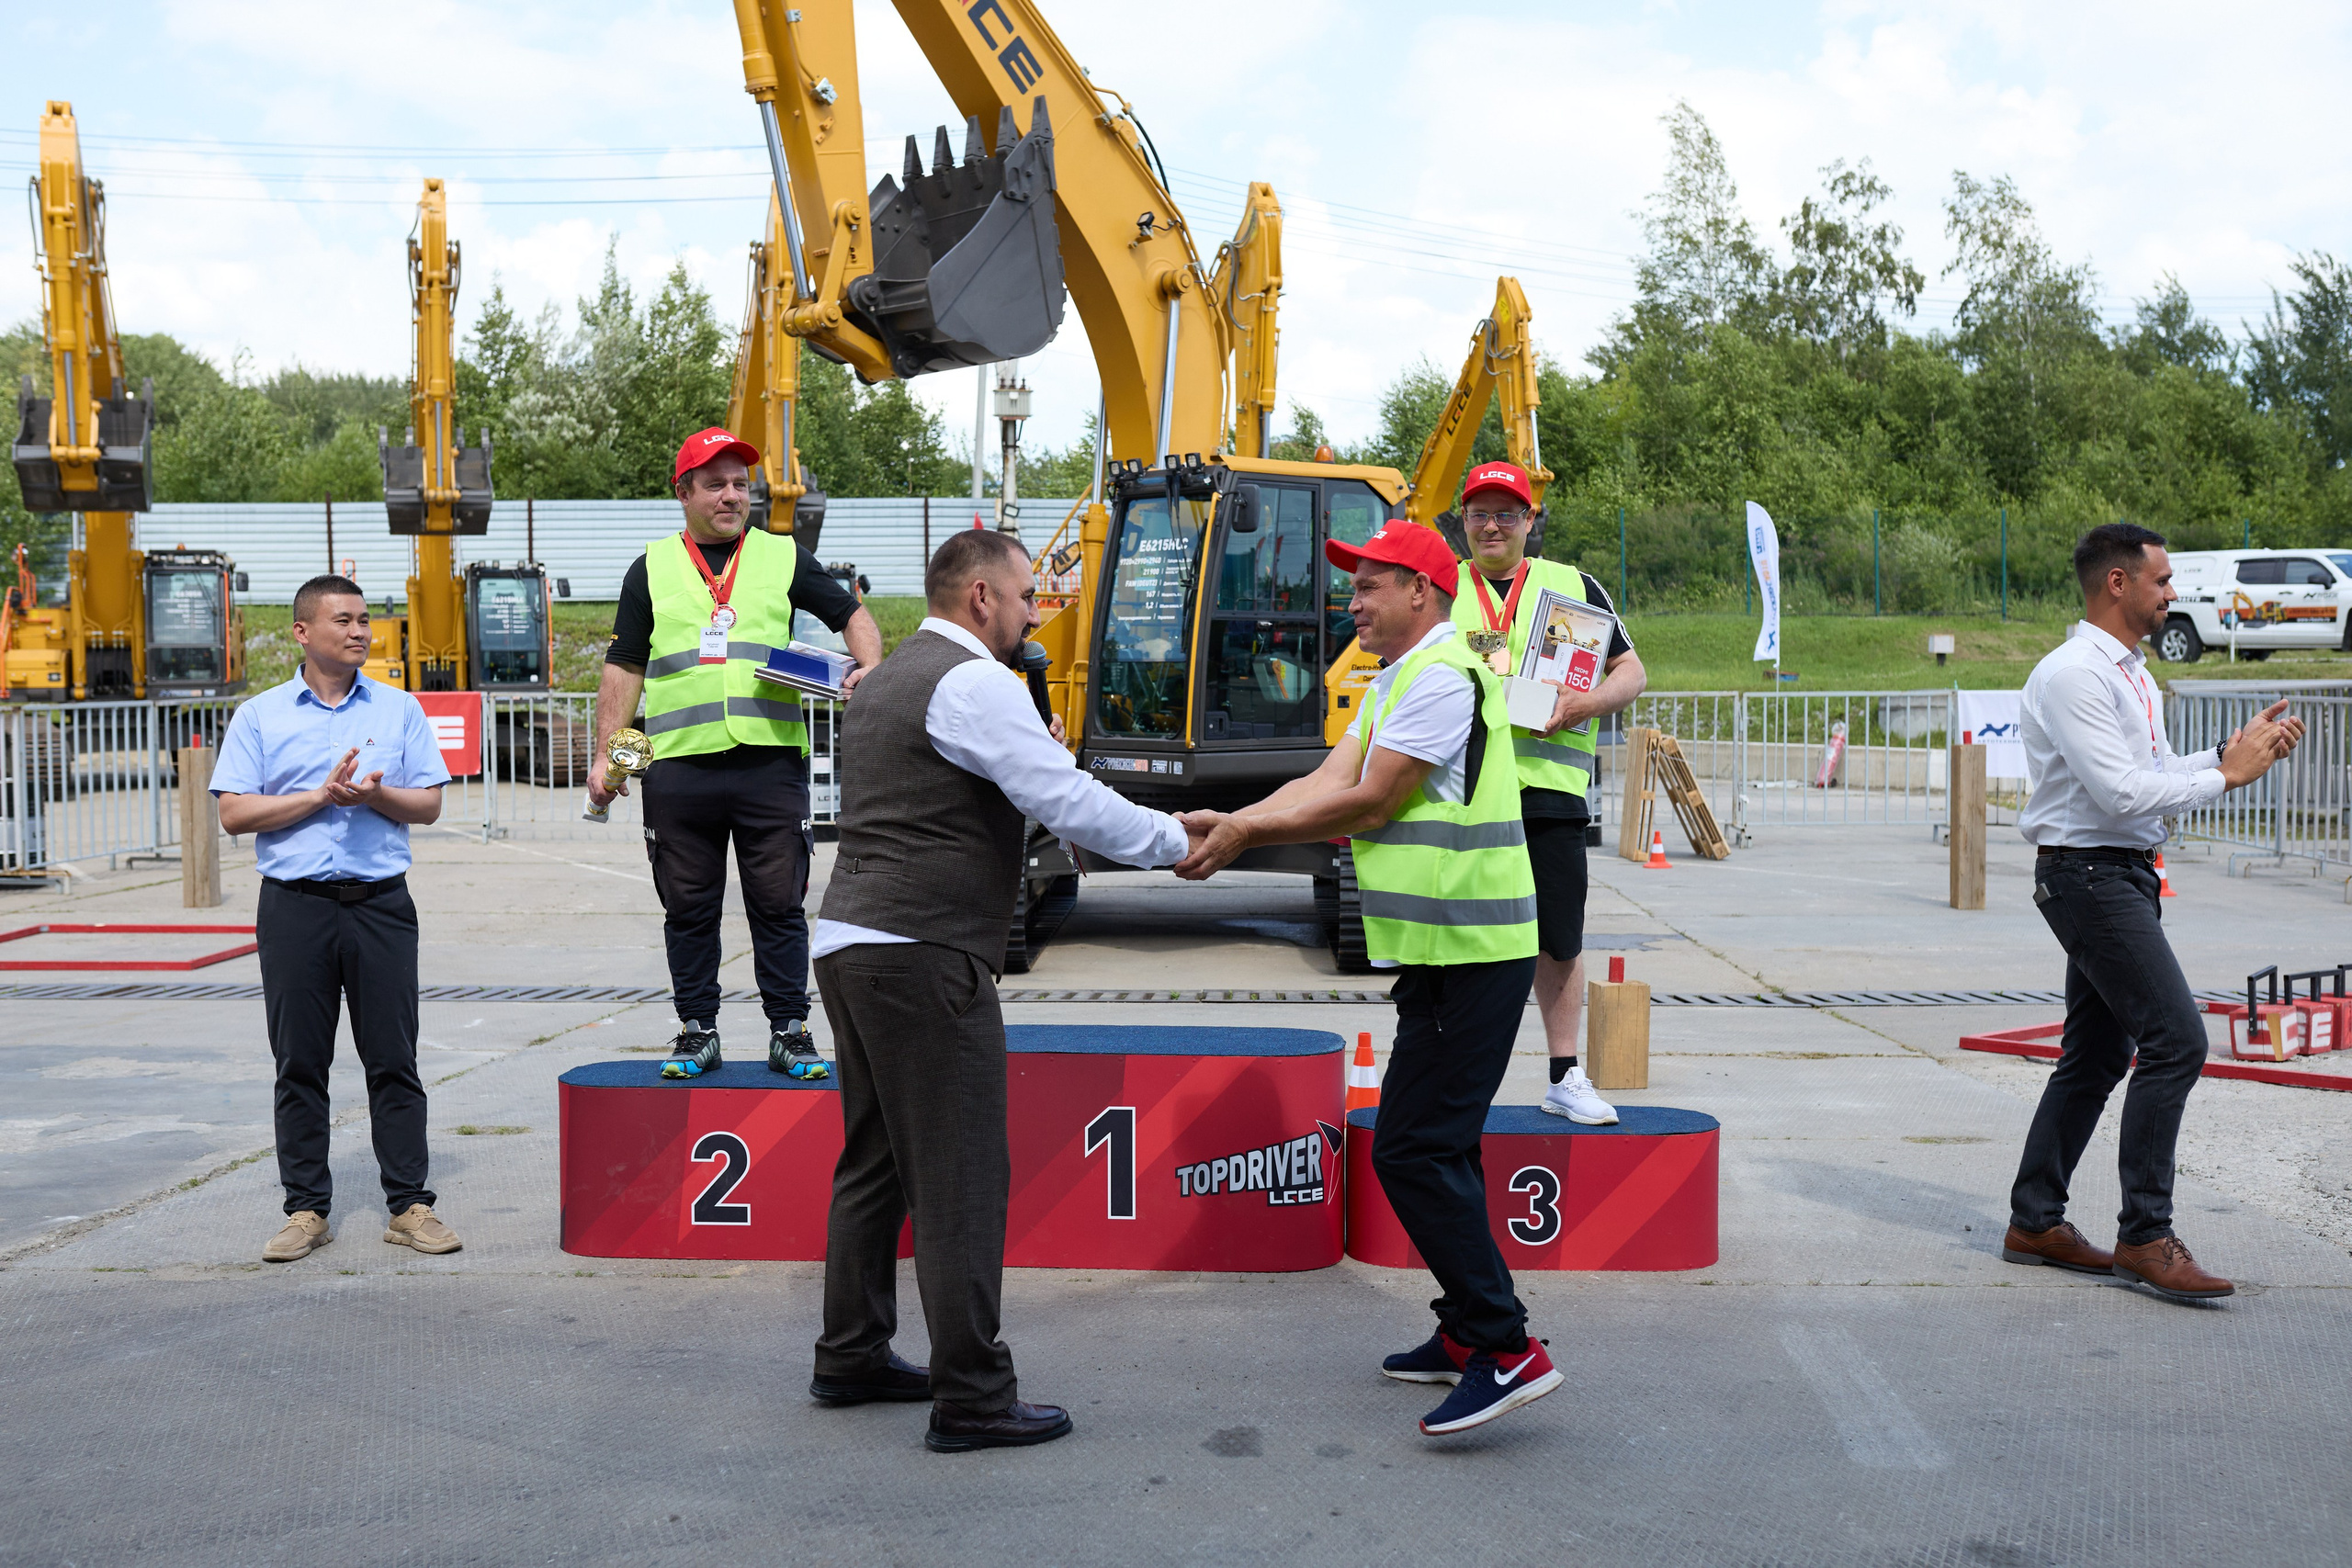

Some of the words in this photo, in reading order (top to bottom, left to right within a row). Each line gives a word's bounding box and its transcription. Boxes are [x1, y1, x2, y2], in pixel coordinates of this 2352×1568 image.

[962, 0, 1044, 95] CE
[1479, 470, 1515, 482] LGCE
[1567, 671, 1590, 690] 15C
[1574, 666, 1589, 675] REDMI
[691, 1131, 752, 1226] 2
[1084, 1106, 1136, 1220] 1
[1175, 1131, 1325, 1198] TOPDRIVER
[1507, 1165, 1562, 1247] 3
